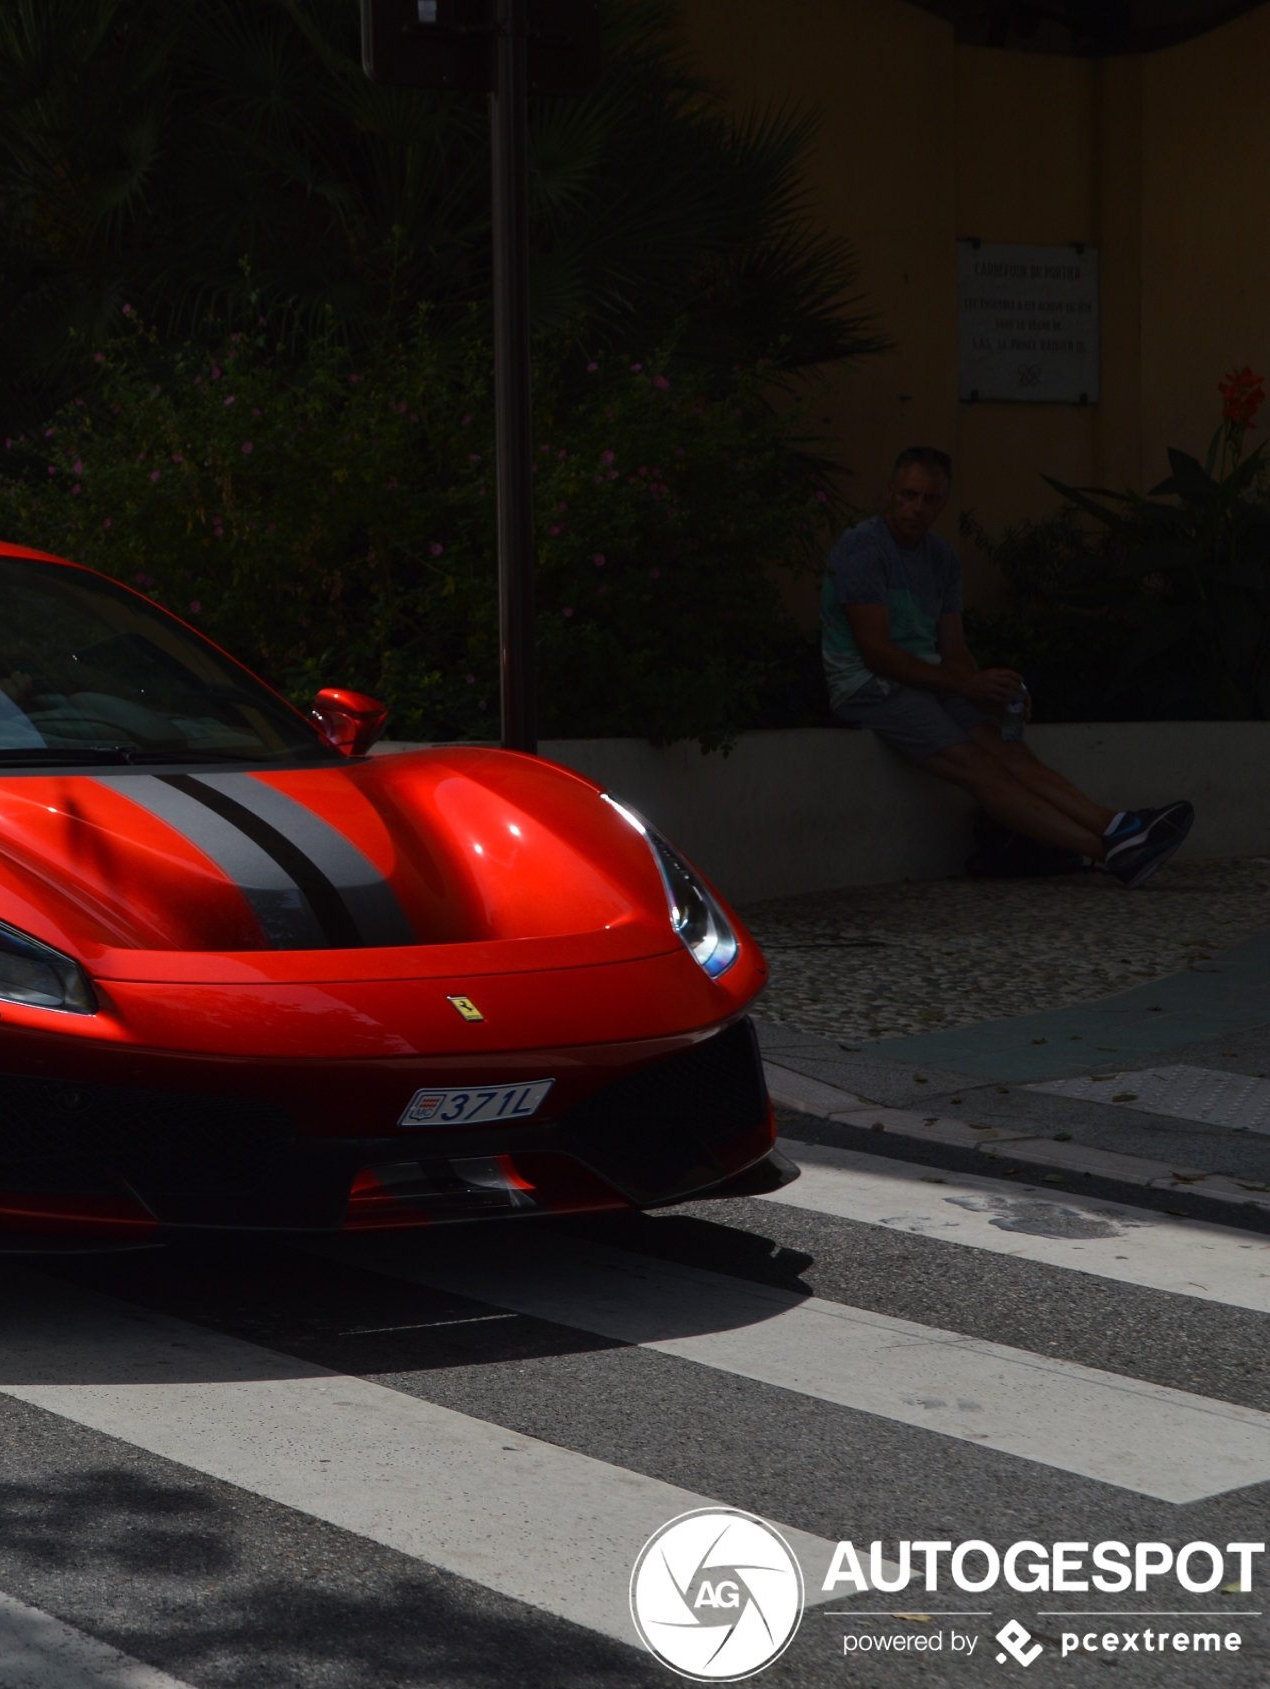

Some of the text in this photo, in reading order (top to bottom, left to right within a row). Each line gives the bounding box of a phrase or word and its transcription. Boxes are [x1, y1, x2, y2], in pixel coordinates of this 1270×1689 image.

[974, 261, 1081, 280] CARREFOUR DU PORTIER
[980, 298, 1015, 311] ENSEMBLE
[1065, 302, 1075, 314] EN
[995, 318, 1014, 330] SOUS
[1017, 319, 1024, 331] LE
[1052, 320, 1061, 332] DE
[998, 338, 1006, 351] LE
[1011, 338, 1037, 351] PRINCE
[1040, 339, 1073, 352] RAINIER
[415, 1088, 532, 1121] MC 371L
